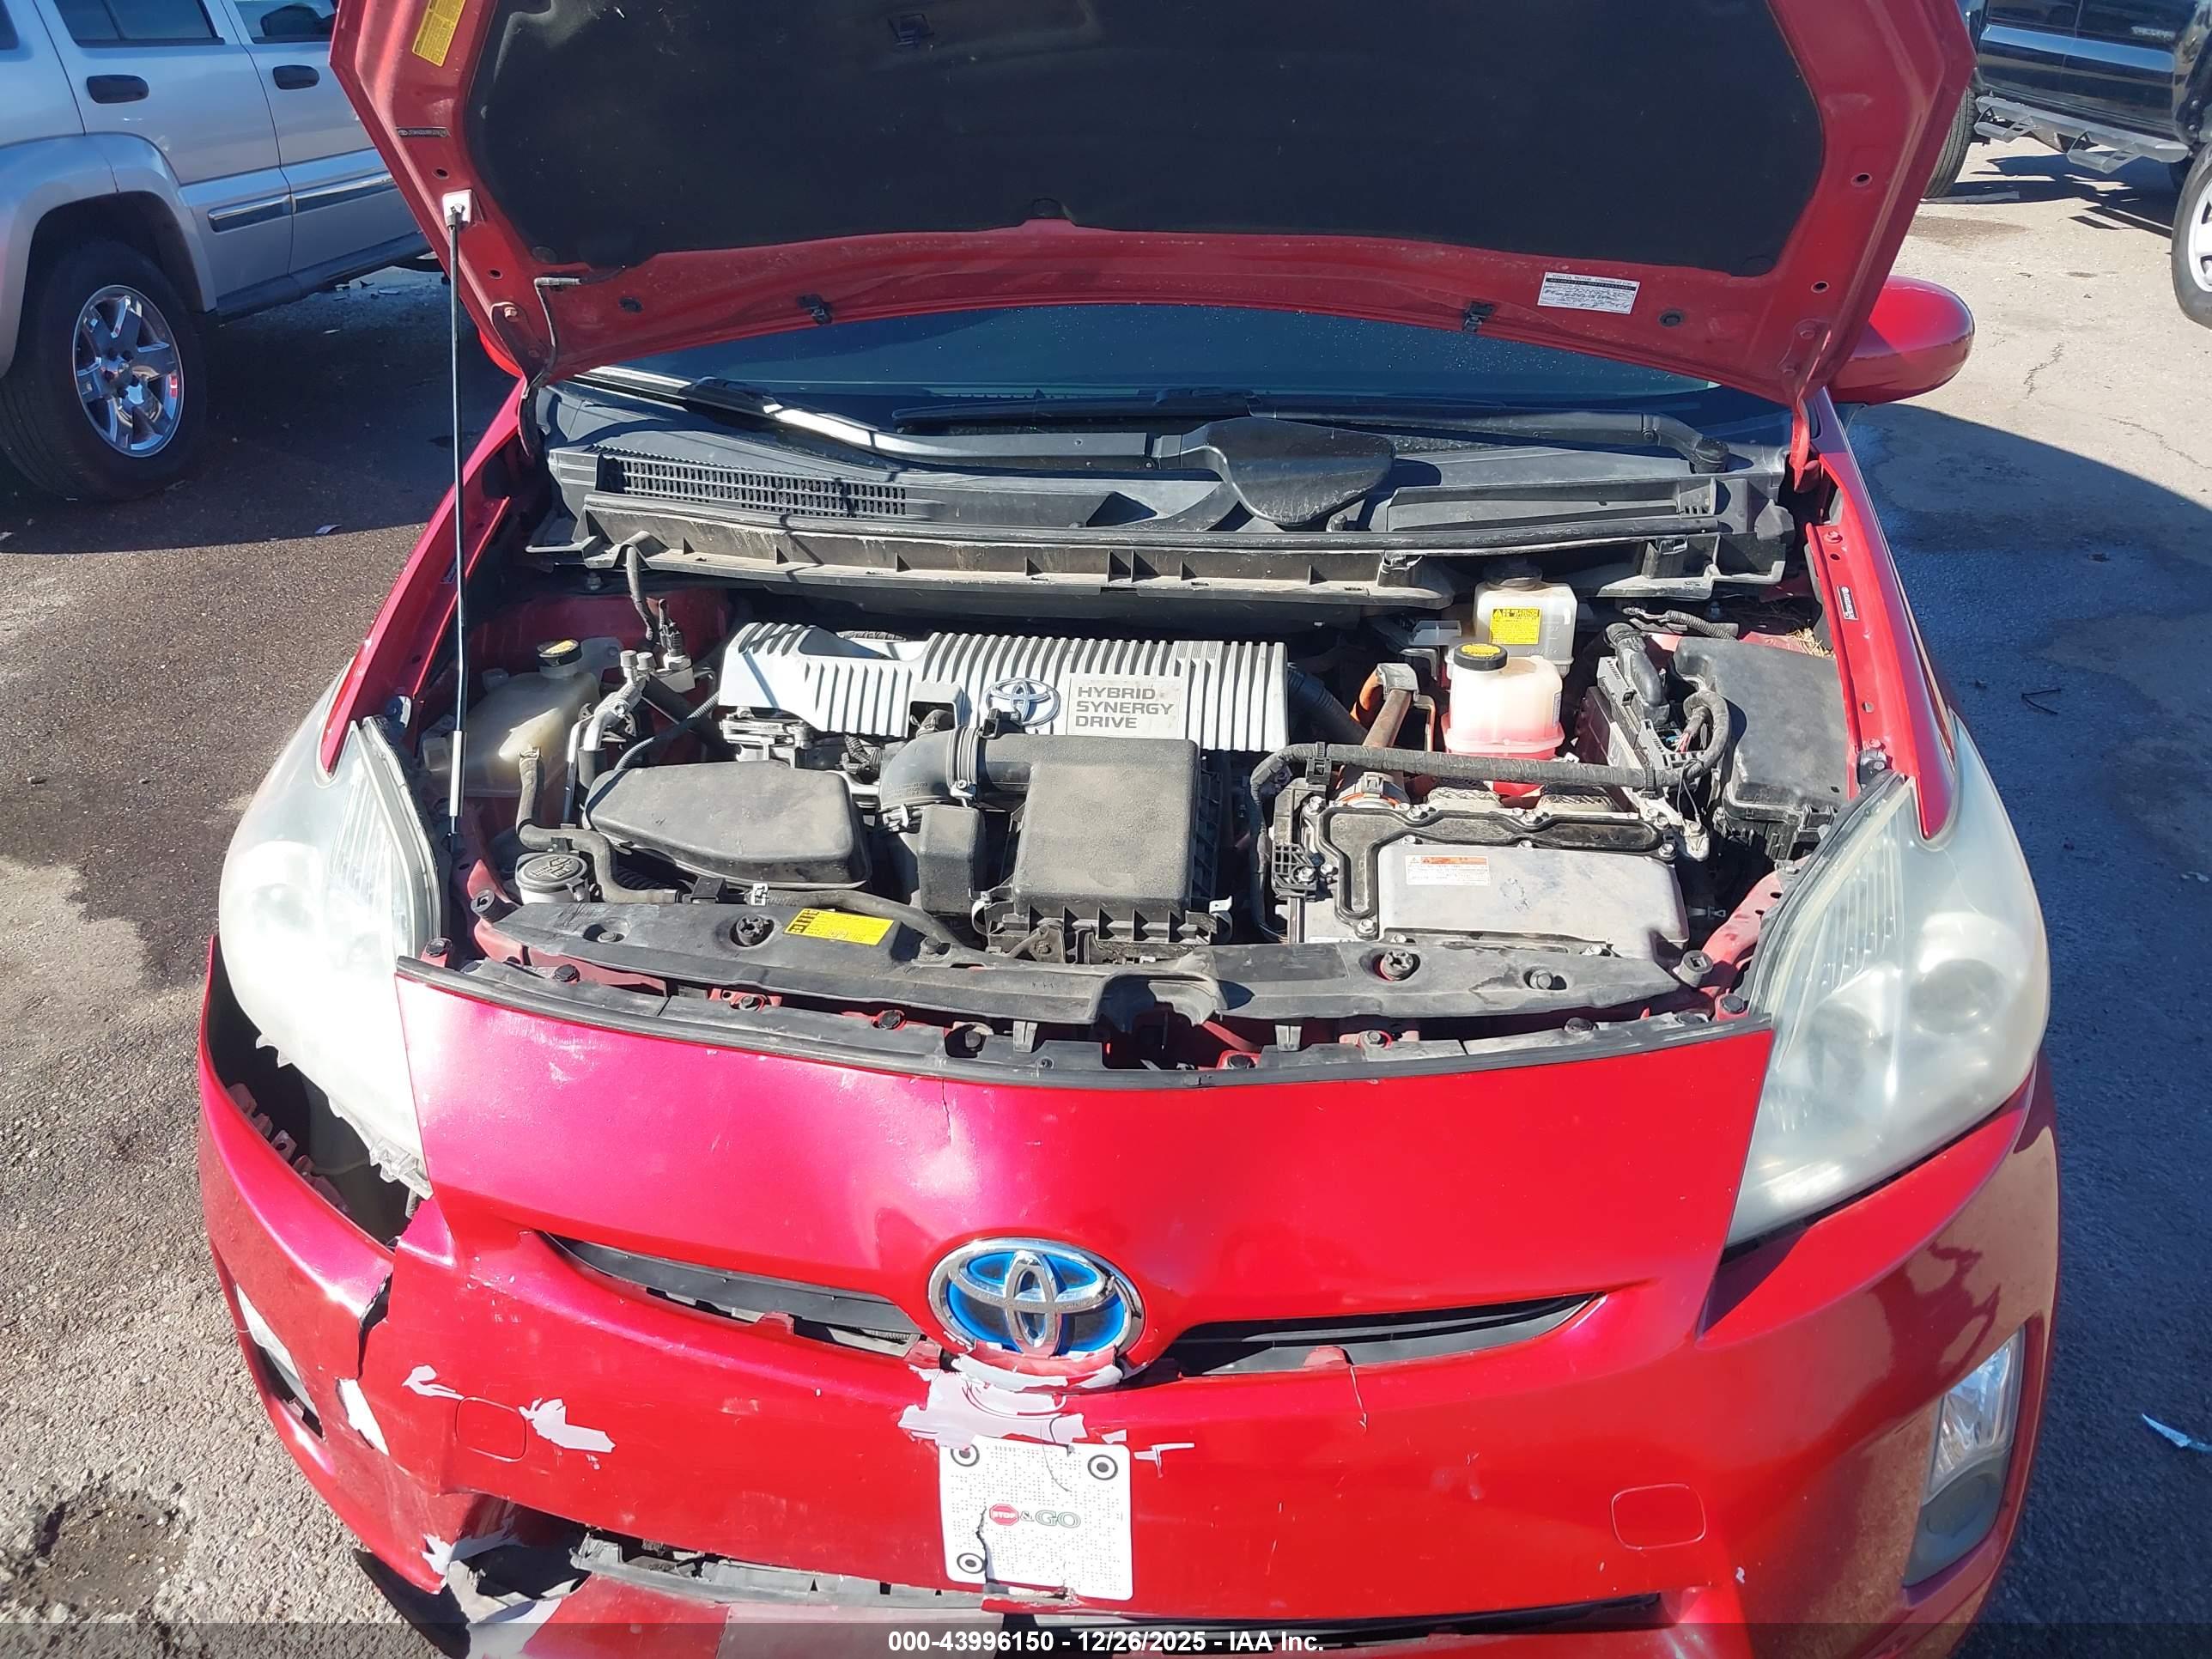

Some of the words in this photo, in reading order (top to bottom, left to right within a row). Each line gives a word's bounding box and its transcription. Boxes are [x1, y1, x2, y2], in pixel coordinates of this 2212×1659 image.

[1078, 686, 1156, 700] HYBRID
[1076, 701, 1175, 715] SYNERGY
[1075, 715, 1138, 729] DRIVE
[1019, 1510, 1035, 1522] &
[1036, 1510, 1082, 1529] GO
